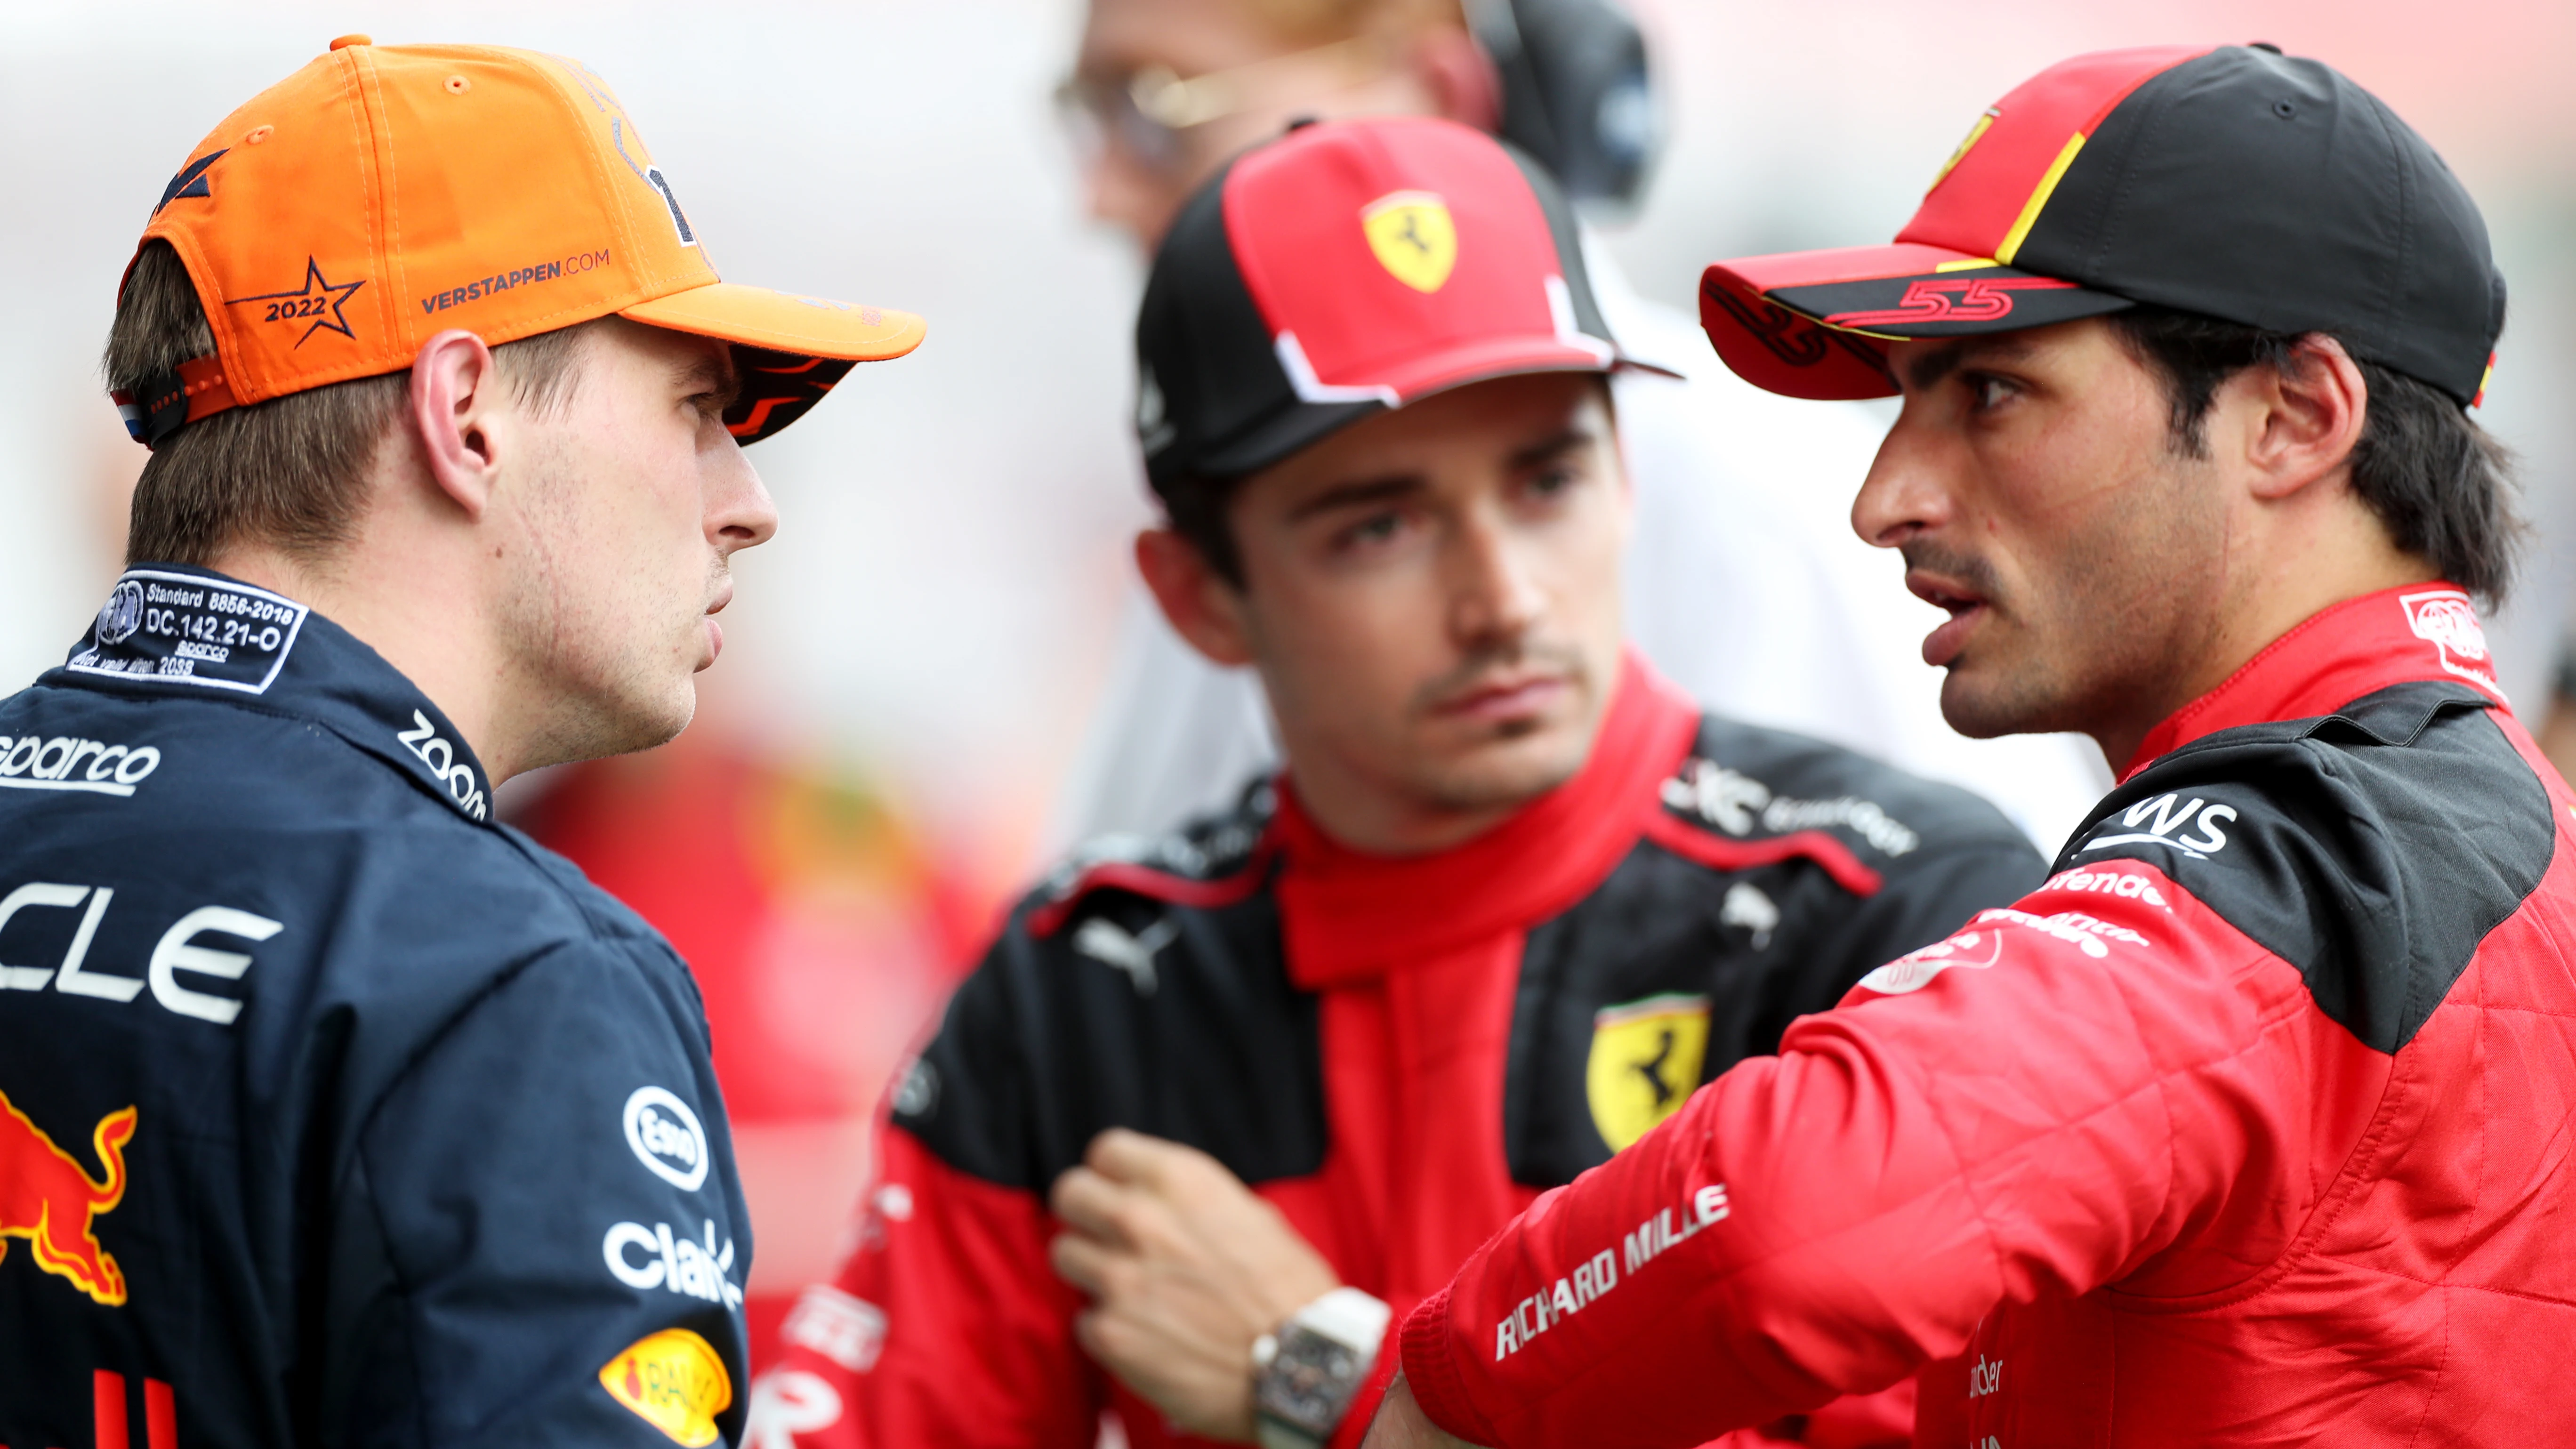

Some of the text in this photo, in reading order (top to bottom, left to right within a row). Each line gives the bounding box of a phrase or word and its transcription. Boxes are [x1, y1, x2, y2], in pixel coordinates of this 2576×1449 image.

[422, 249, 610, 314] VERSTAPPEN.COM
[1898, 278, 2014, 322] 55
[265, 297, 326, 322] 2022
[146, 583, 294, 626] Standard 8856-2018
[176, 639, 230, 661] sparco
[2121, 793, 2238, 853] WS
[1495, 1182, 1731, 1362] RICHARD MILLE
